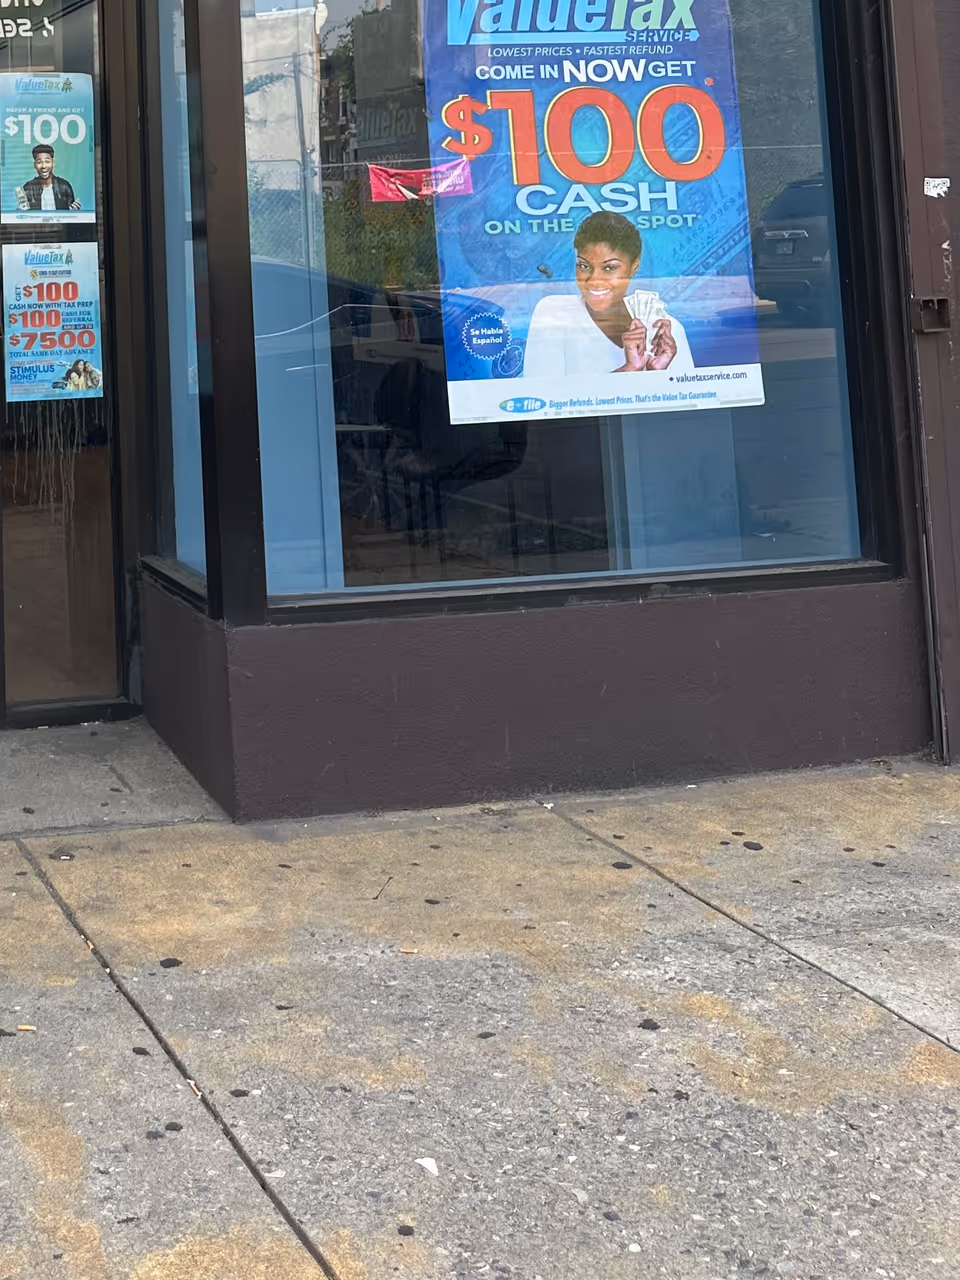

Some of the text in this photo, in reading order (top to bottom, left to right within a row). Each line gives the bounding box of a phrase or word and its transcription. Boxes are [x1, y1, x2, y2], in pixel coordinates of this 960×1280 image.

[624, 30, 692, 42] SERVICE
[487, 44, 674, 58] LOWEST PRICES FASTEST REFUND
[475, 58, 696, 83] COME IN NOW GET
[4, 113, 87, 145] $100
[515, 180, 679, 216] CASH
[483, 213, 698, 235] ON THE SPOT
[22, 281, 79, 302] $100
[77, 300, 94, 308] PREP
[8, 309, 62, 328] $100
[470, 326, 504, 336] Se Habla
[8, 329, 96, 351] $7500
[472, 335, 503, 346] Español
[8, 351, 30, 359] TOTAL
[10, 364, 55, 375] STIMULUS
[10, 373, 38, 381] MONEY
[676, 371, 748, 384] valuetaxservice.com
[549, 399, 569, 410] Bigger
[595, 396, 616, 406] Lowest
[651, 393, 661, 402] the
[661, 393, 678, 402] Value
[678, 392, 688, 401] Tax
